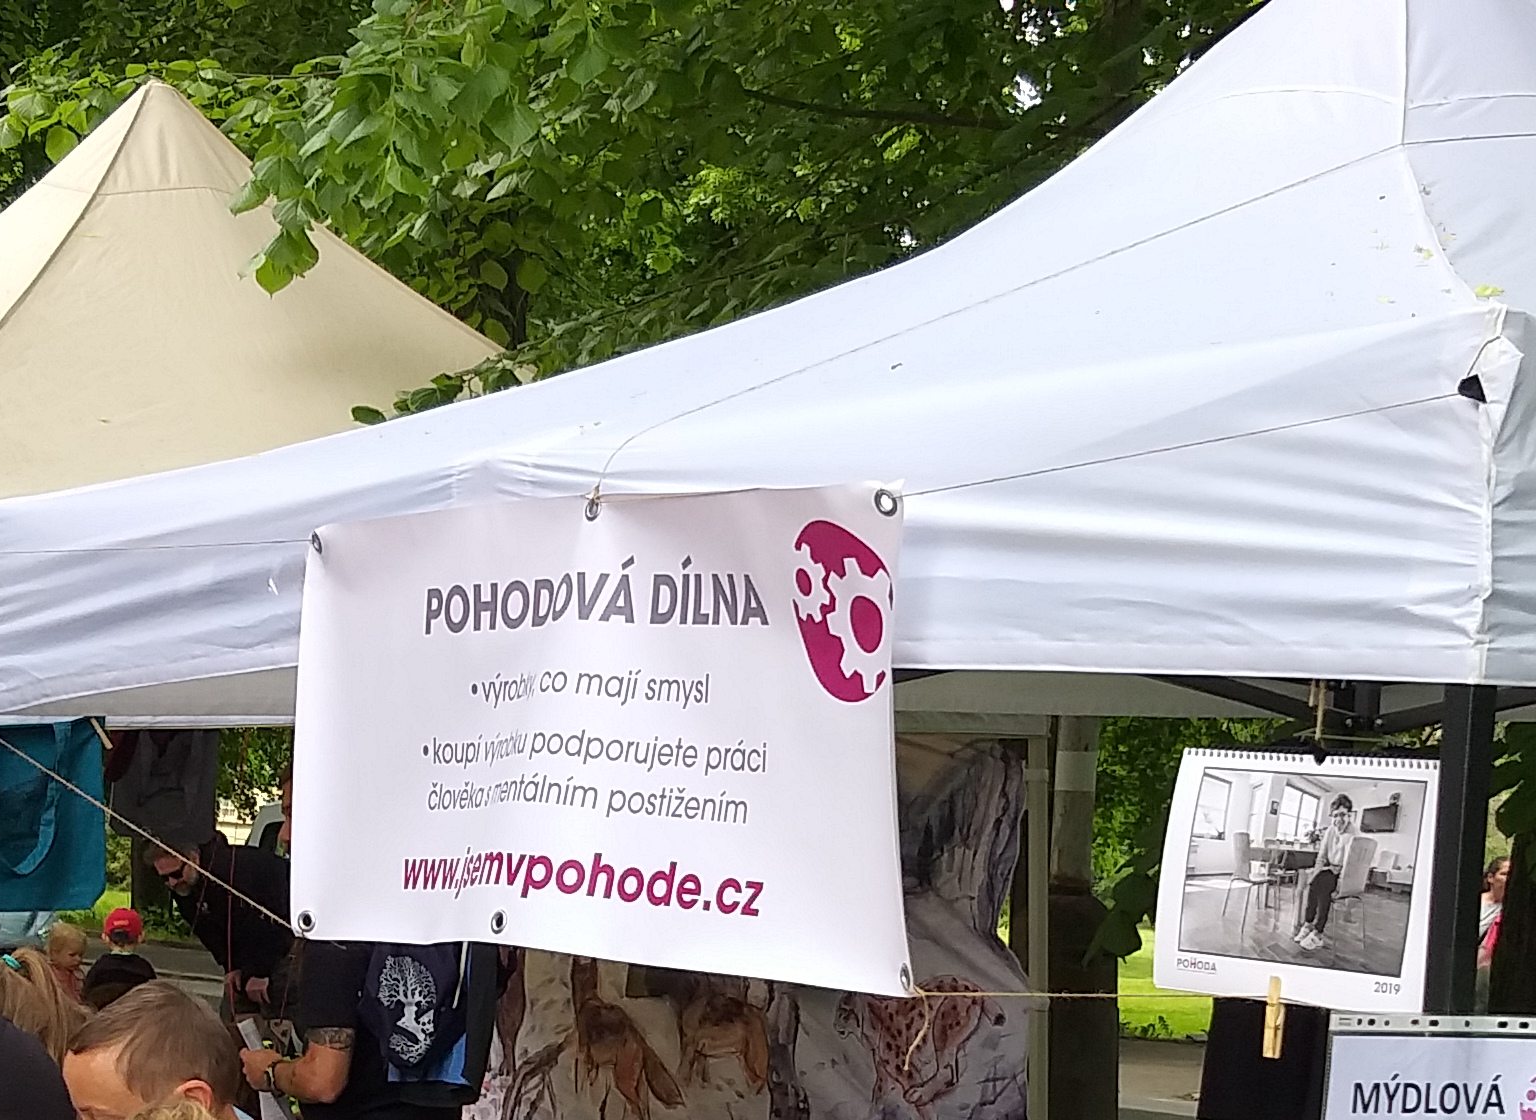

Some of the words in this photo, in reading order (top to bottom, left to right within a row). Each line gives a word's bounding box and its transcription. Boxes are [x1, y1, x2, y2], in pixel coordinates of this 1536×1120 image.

[425, 555, 636, 635] POHODOVÁ
[649, 555, 770, 626] DÍLNA
[539, 670, 568, 694] co
[575, 668, 642, 707] mají
[644, 673, 710, 710] smysl
[432, 734, 483, 769] koupí
[528, 729, 698, 773] podporujete
[705, 739, 768, 776] práci
[427, 780, 483, 812] člověka
[490, 772, 599, 810] mentálním
[606, 786, 749, 825] postižením
[403, 846, 765, 917] www.jsemvpohode.cz
[1176, 956, 1217, 972] POHODA
[1373, 981, 1401, 996] 2019
[1351, 1073, 1506, 1116] MÝDLOVÁ
